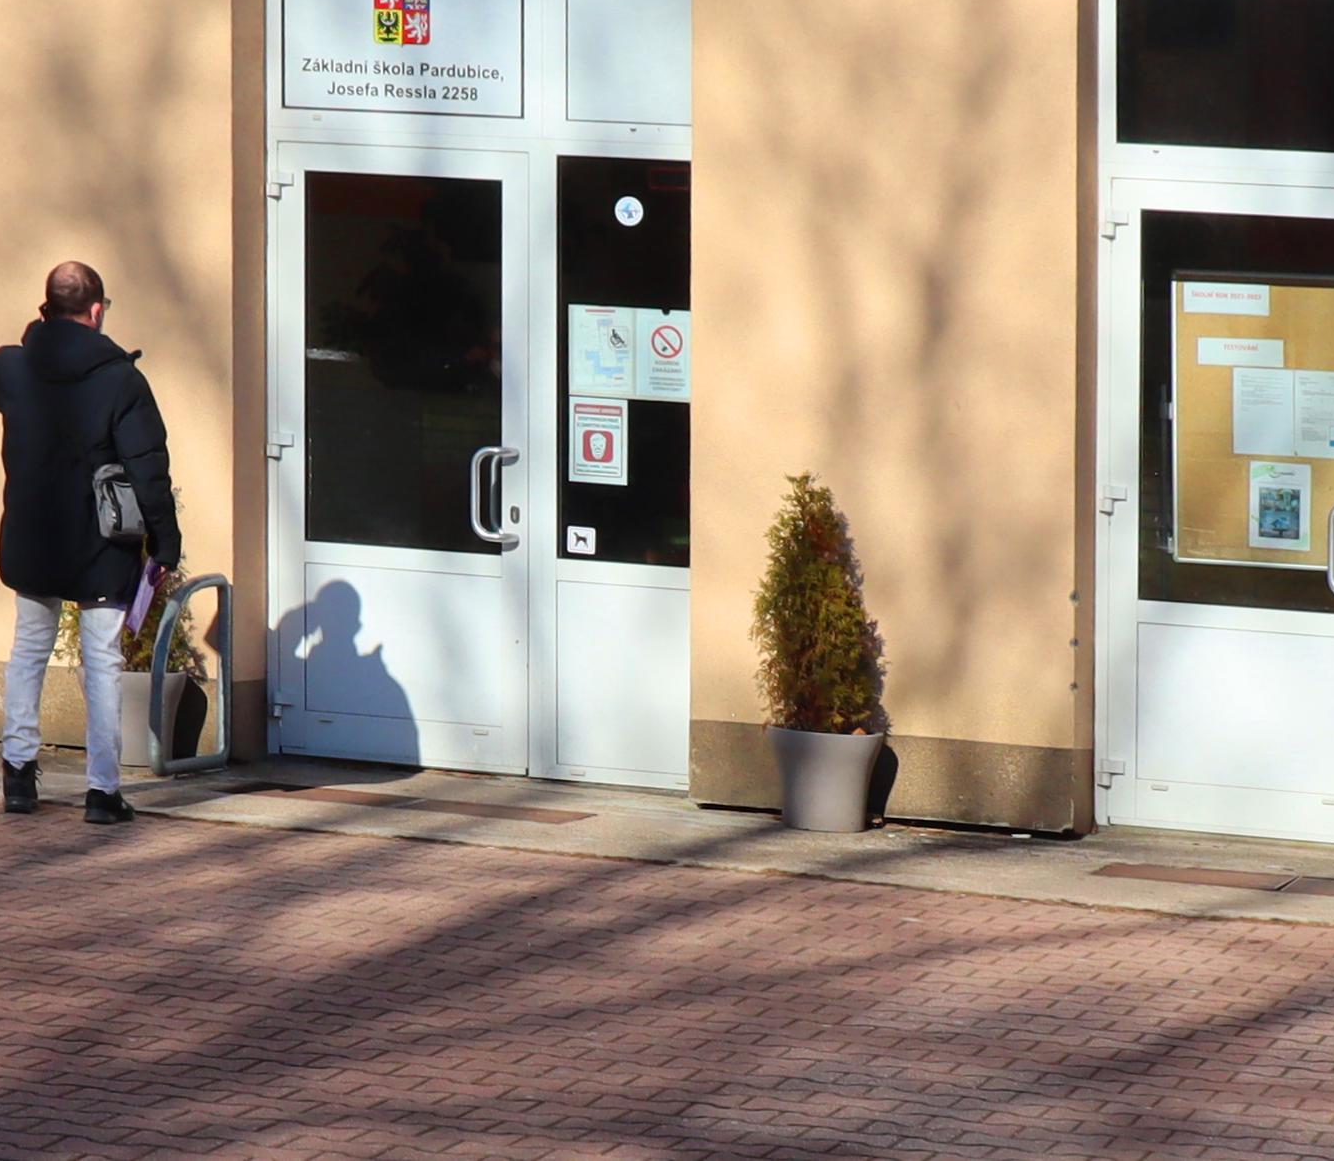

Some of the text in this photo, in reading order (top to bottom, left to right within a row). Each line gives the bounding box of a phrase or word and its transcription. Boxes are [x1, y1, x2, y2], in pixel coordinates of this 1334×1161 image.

[301, 57, 504, 82] Základní škola Pardubice,
[327, 81, 478, 101] Josefa Ressla 2258
